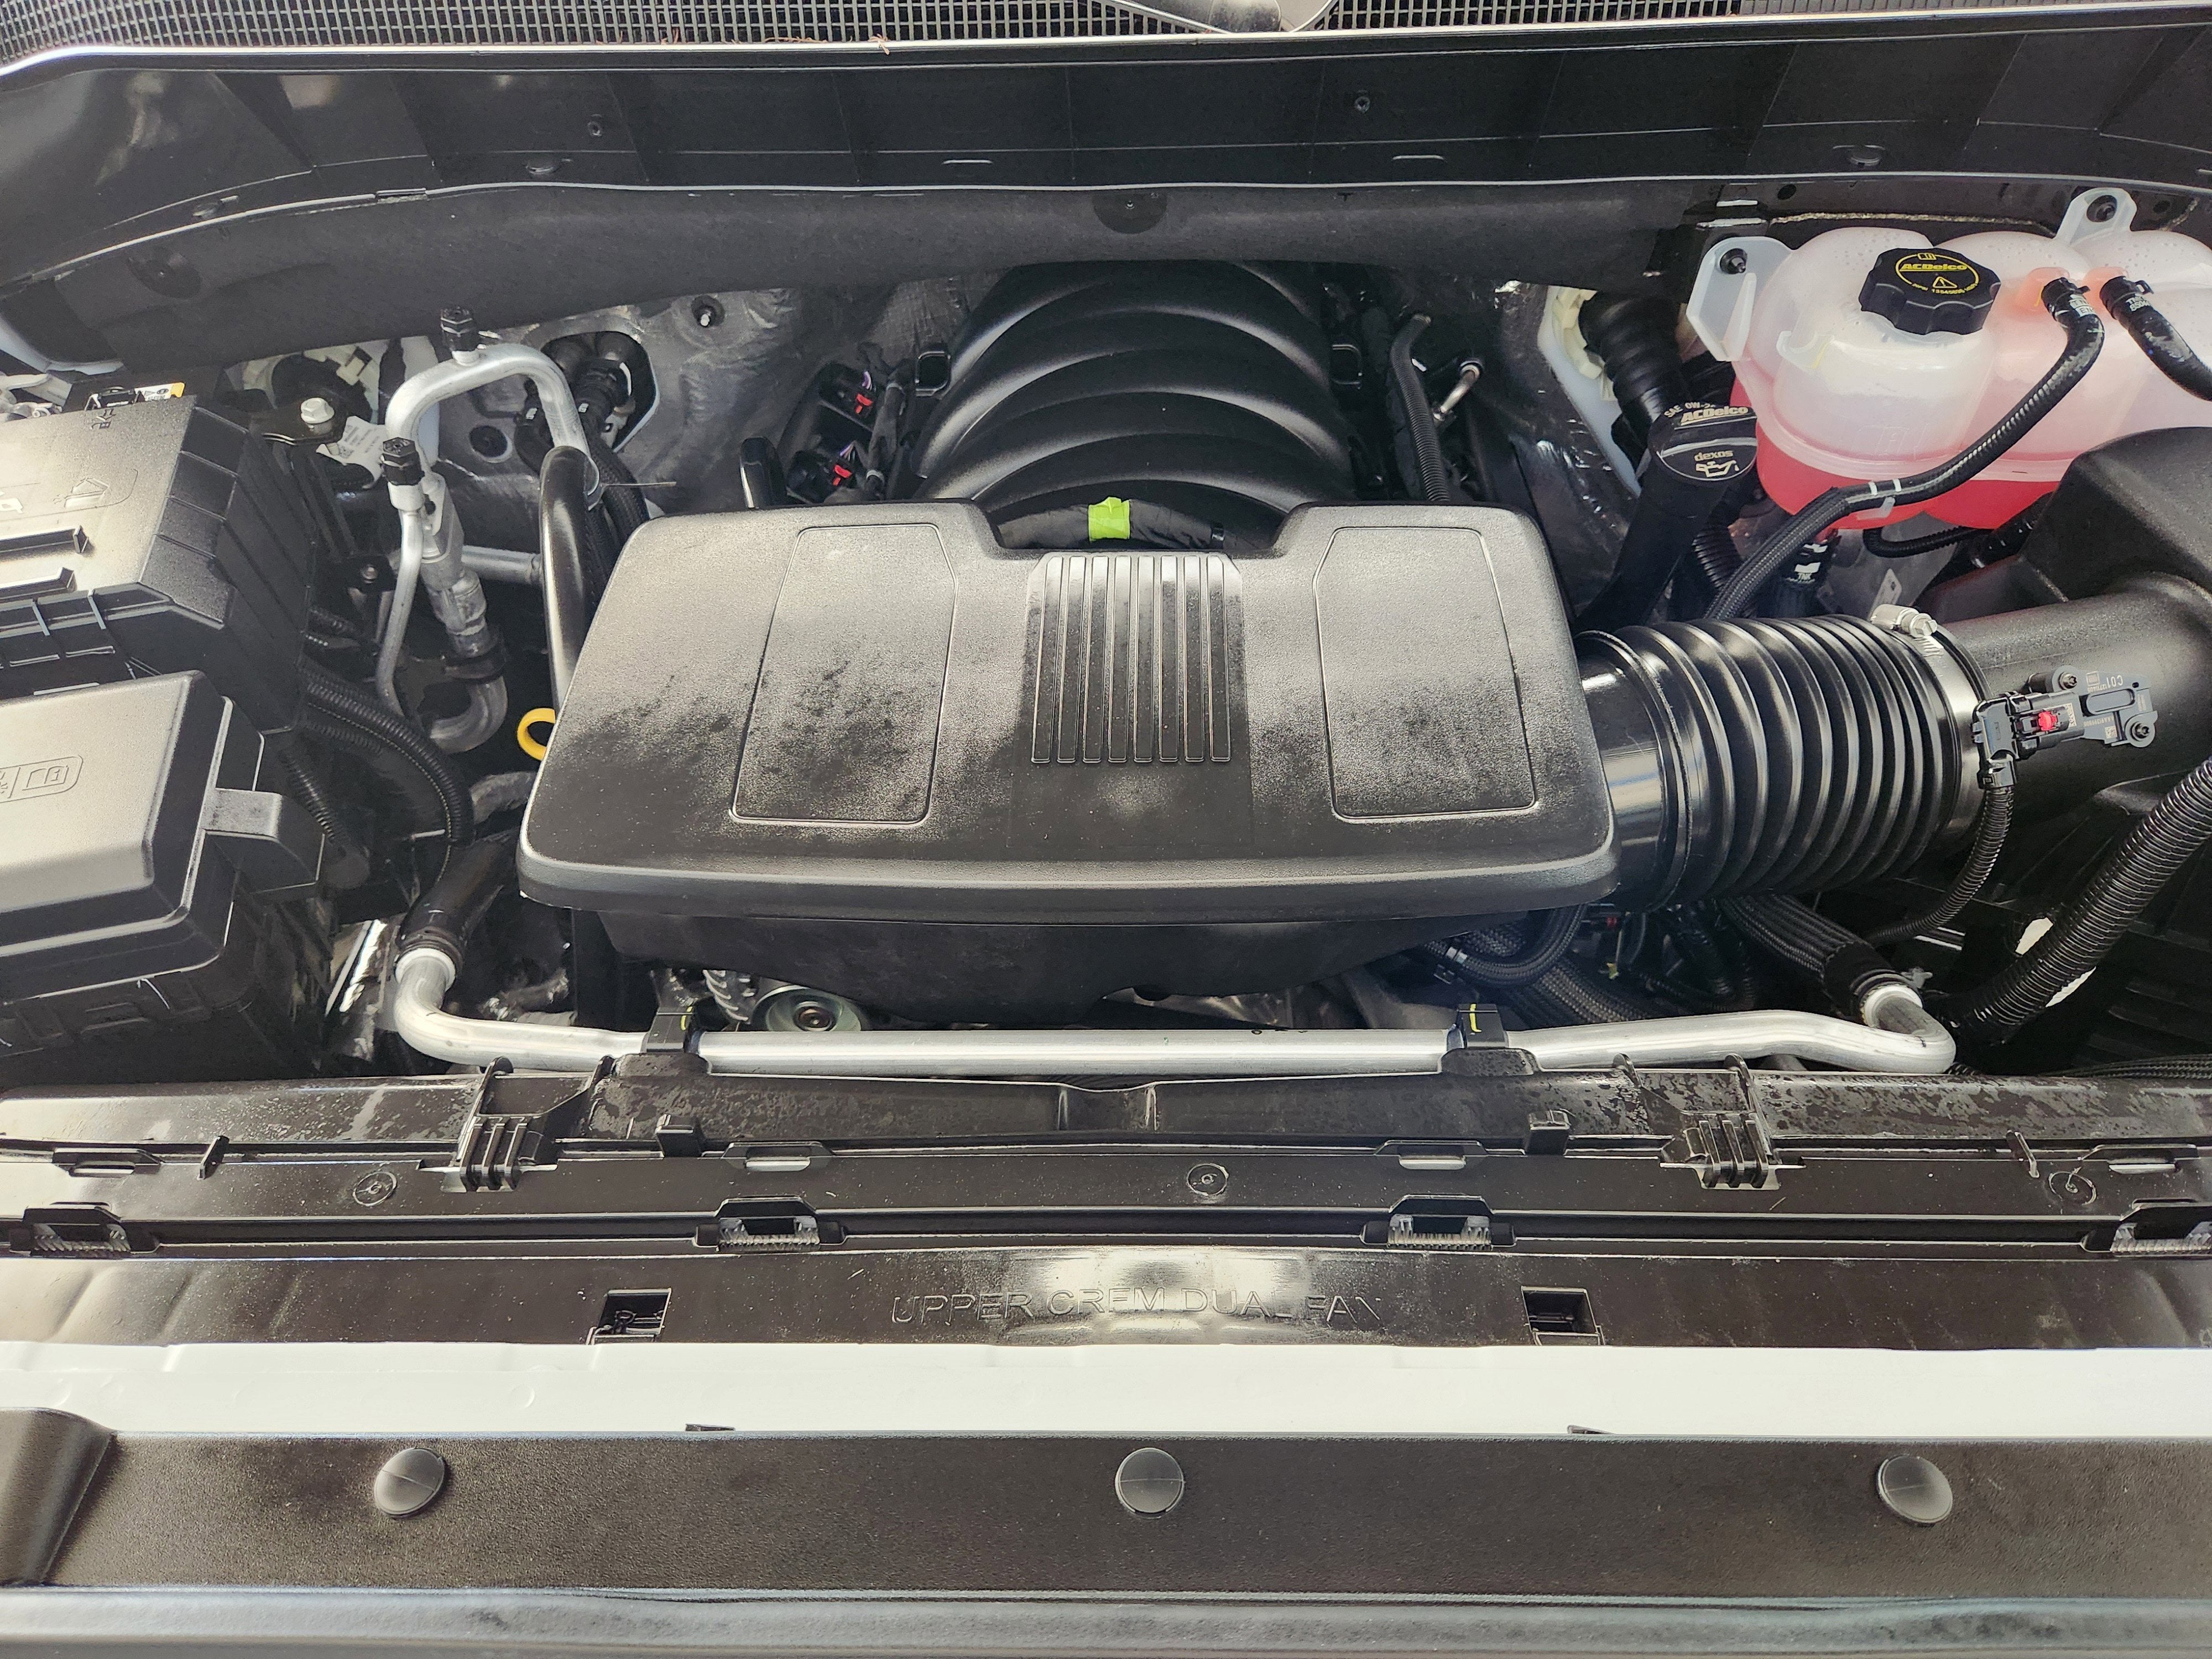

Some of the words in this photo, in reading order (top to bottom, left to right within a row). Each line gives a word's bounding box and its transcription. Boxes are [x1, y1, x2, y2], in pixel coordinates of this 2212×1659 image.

[1664, 405, 1683, 418] SAE
[1680, 406, 1748, 425] ACDelco
[1694, 450, 1733, 461] dexos
[891, 1290, 1034, 1326] UPPER
[1181, 1287, 1292, 1319] DUAL
[1311, 1295, 1381, 1323] FAN
